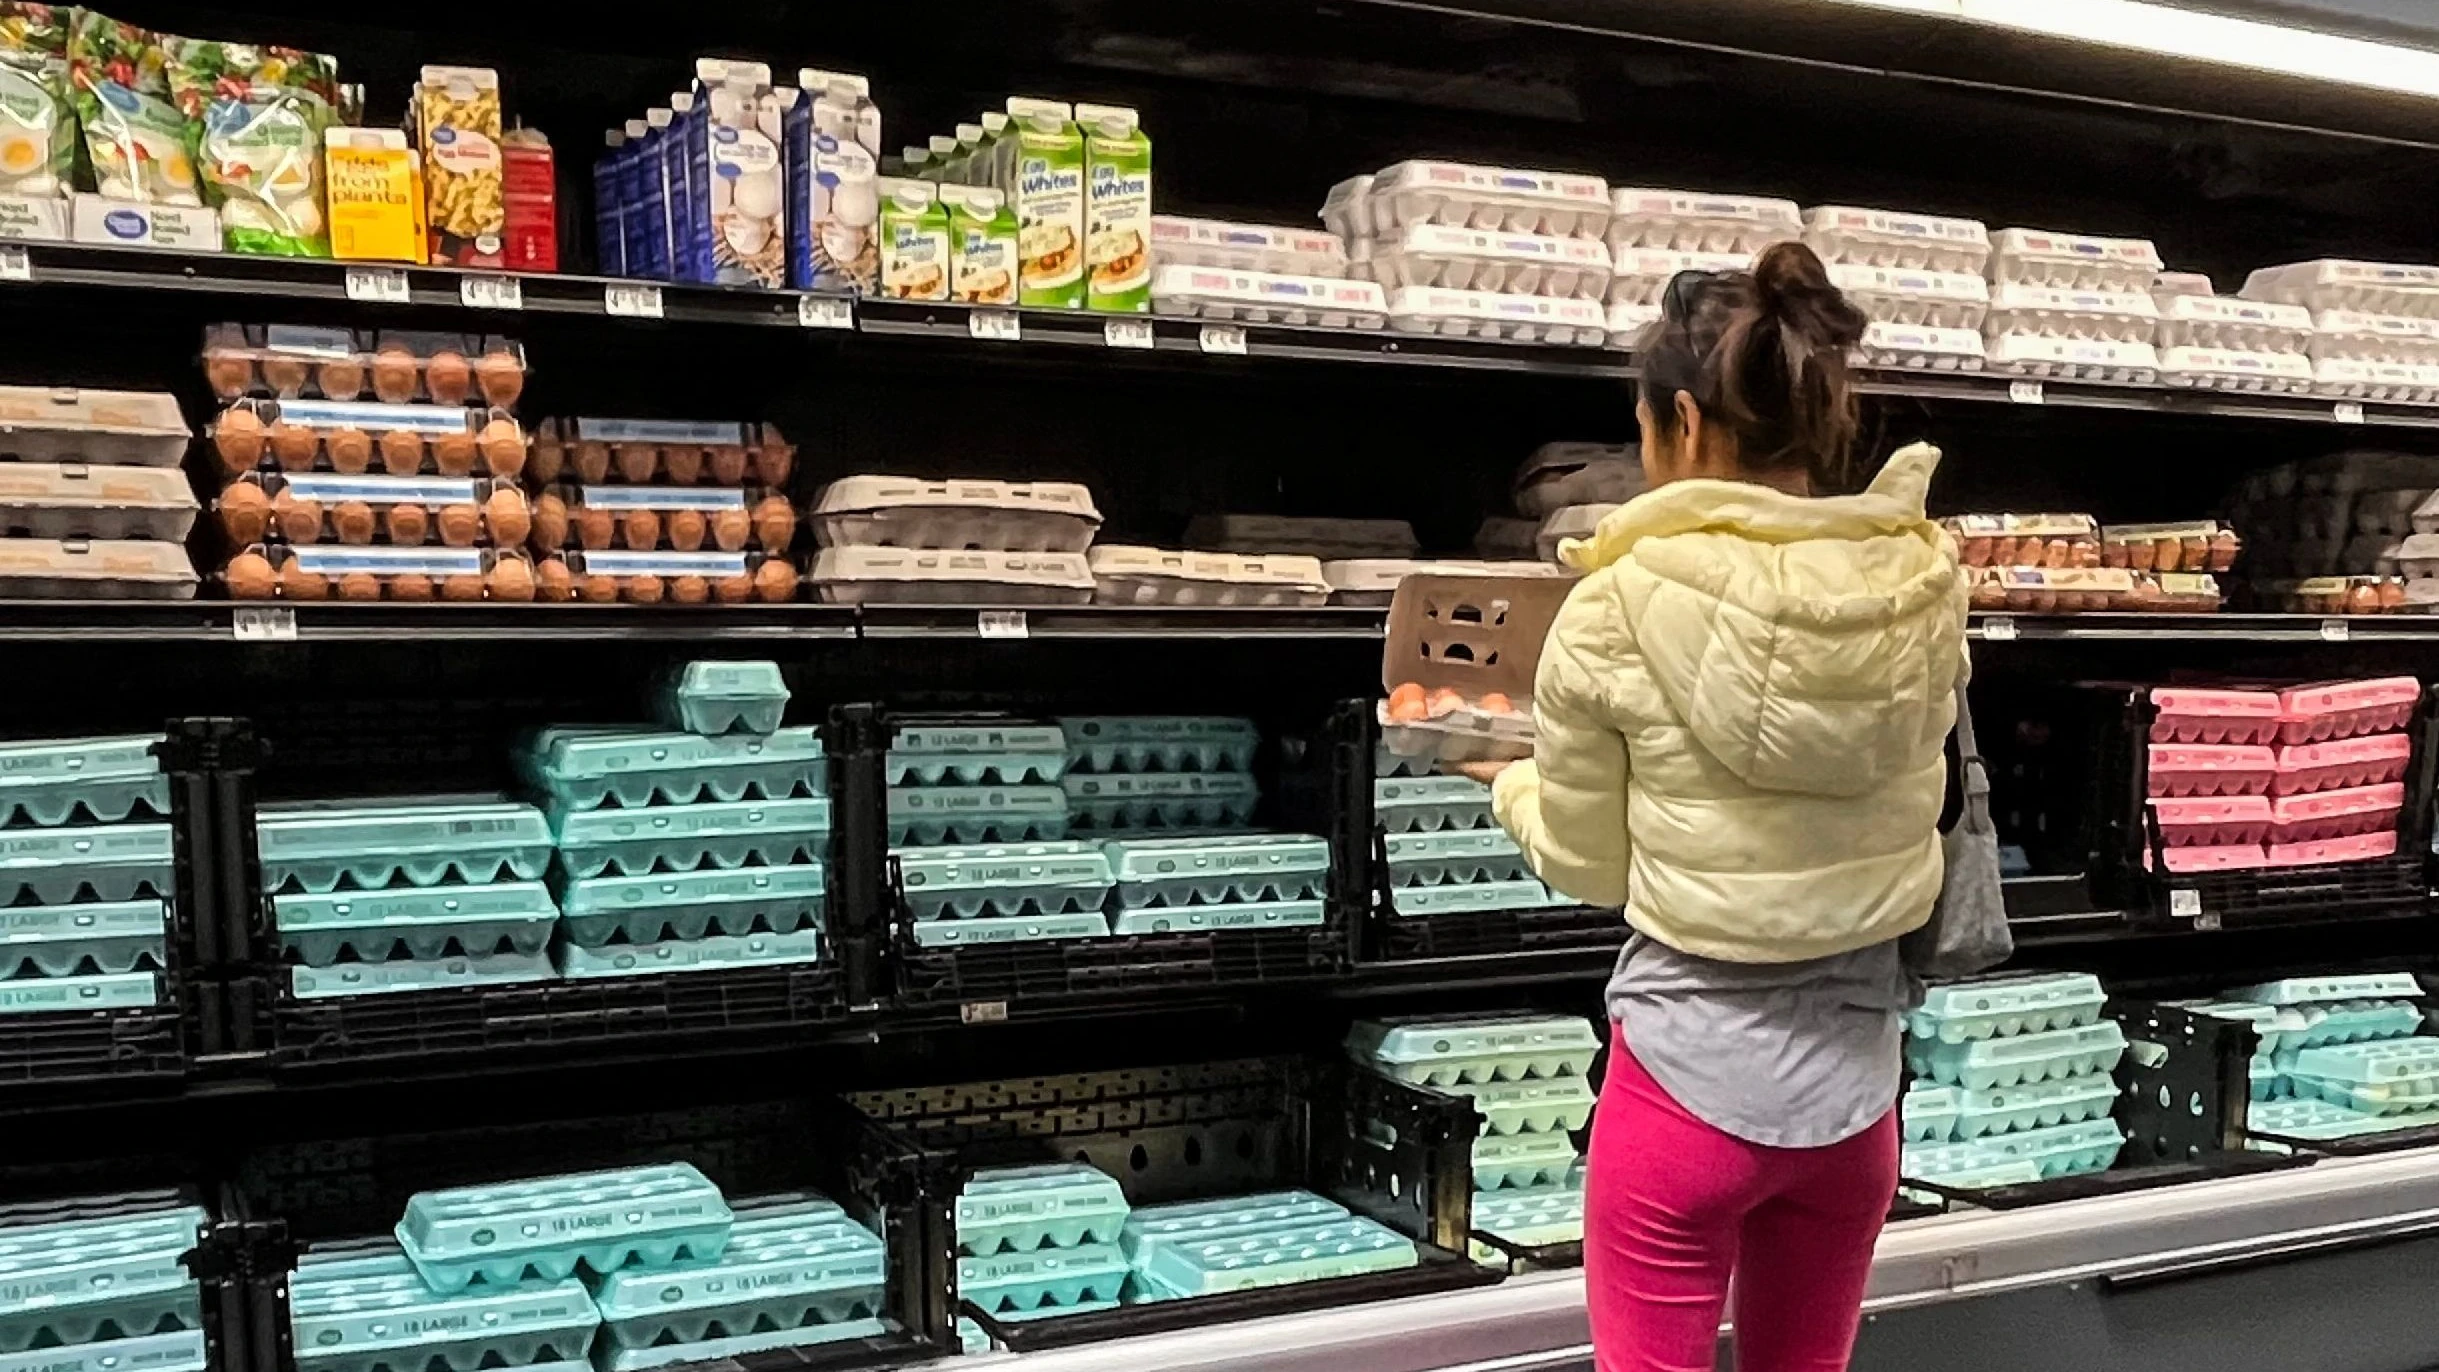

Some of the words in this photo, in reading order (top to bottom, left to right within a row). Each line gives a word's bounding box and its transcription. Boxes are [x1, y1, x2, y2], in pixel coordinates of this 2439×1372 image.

[1022, 173, 1077, 195] Whites
[1092, 179, 1144, 200] Whites
[985, 867, 1020, 879] LARGE
[570, 1213, 612, 1229] LARGE
[753, 1272, 793, 1288] LARGE
[25, 1279, 77, 1298] LARGE
[423, 1315, 467, 1331] LARGE
